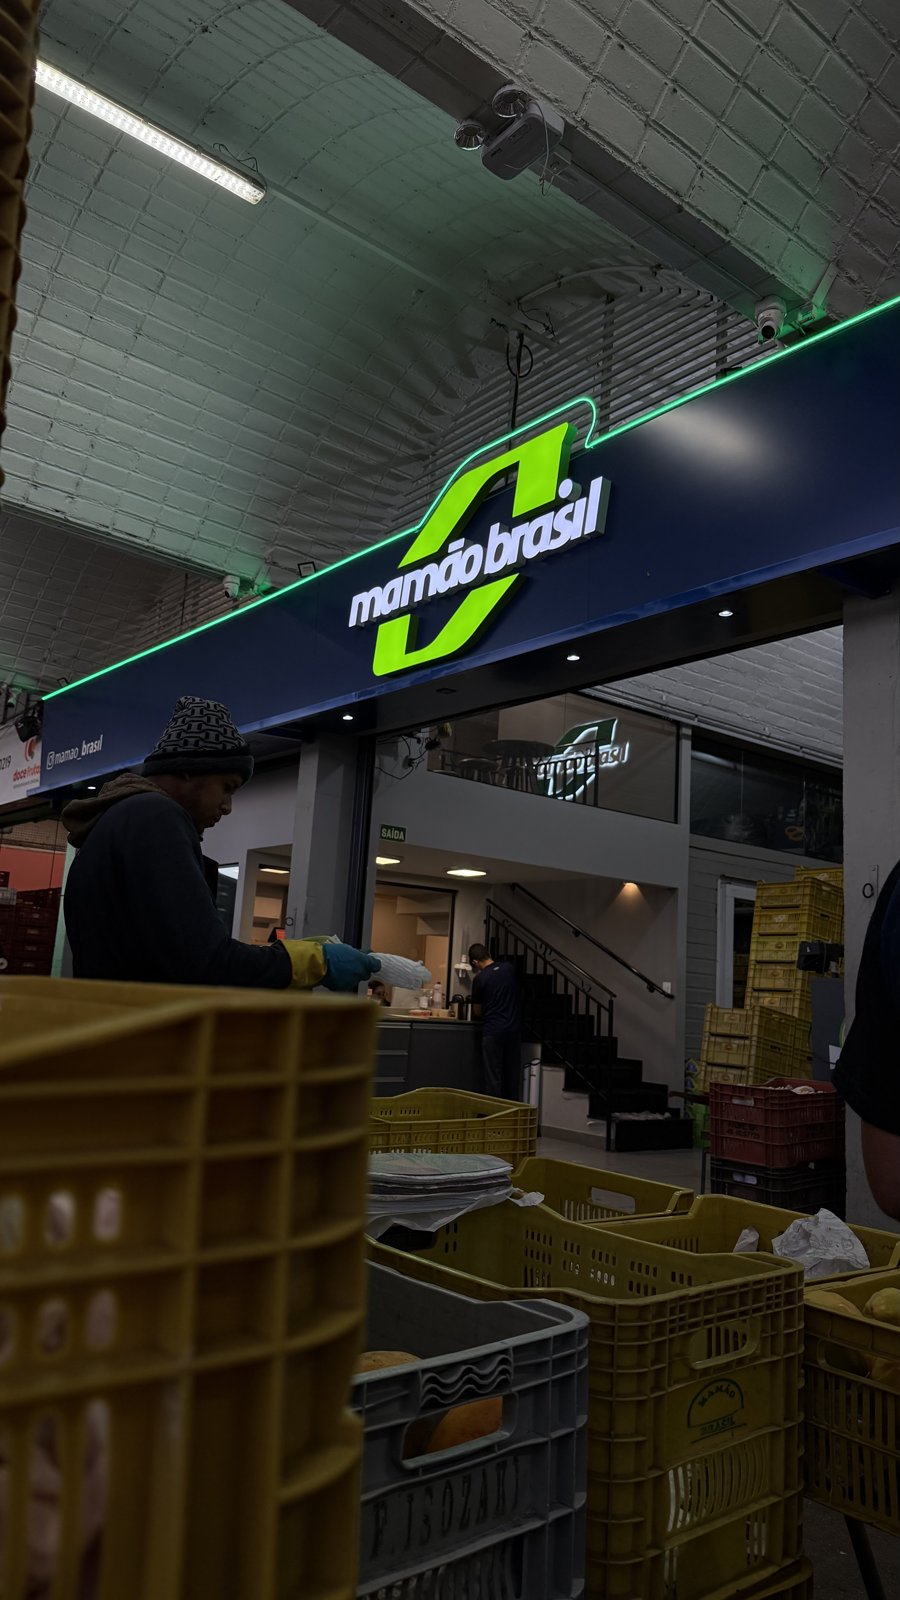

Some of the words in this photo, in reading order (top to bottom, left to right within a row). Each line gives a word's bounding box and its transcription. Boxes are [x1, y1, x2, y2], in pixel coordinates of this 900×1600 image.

[348, 537, 485, 628] mamão
[484, 475, 605, 575] brasil
[381, 826, 405, 841] SAÍDA
